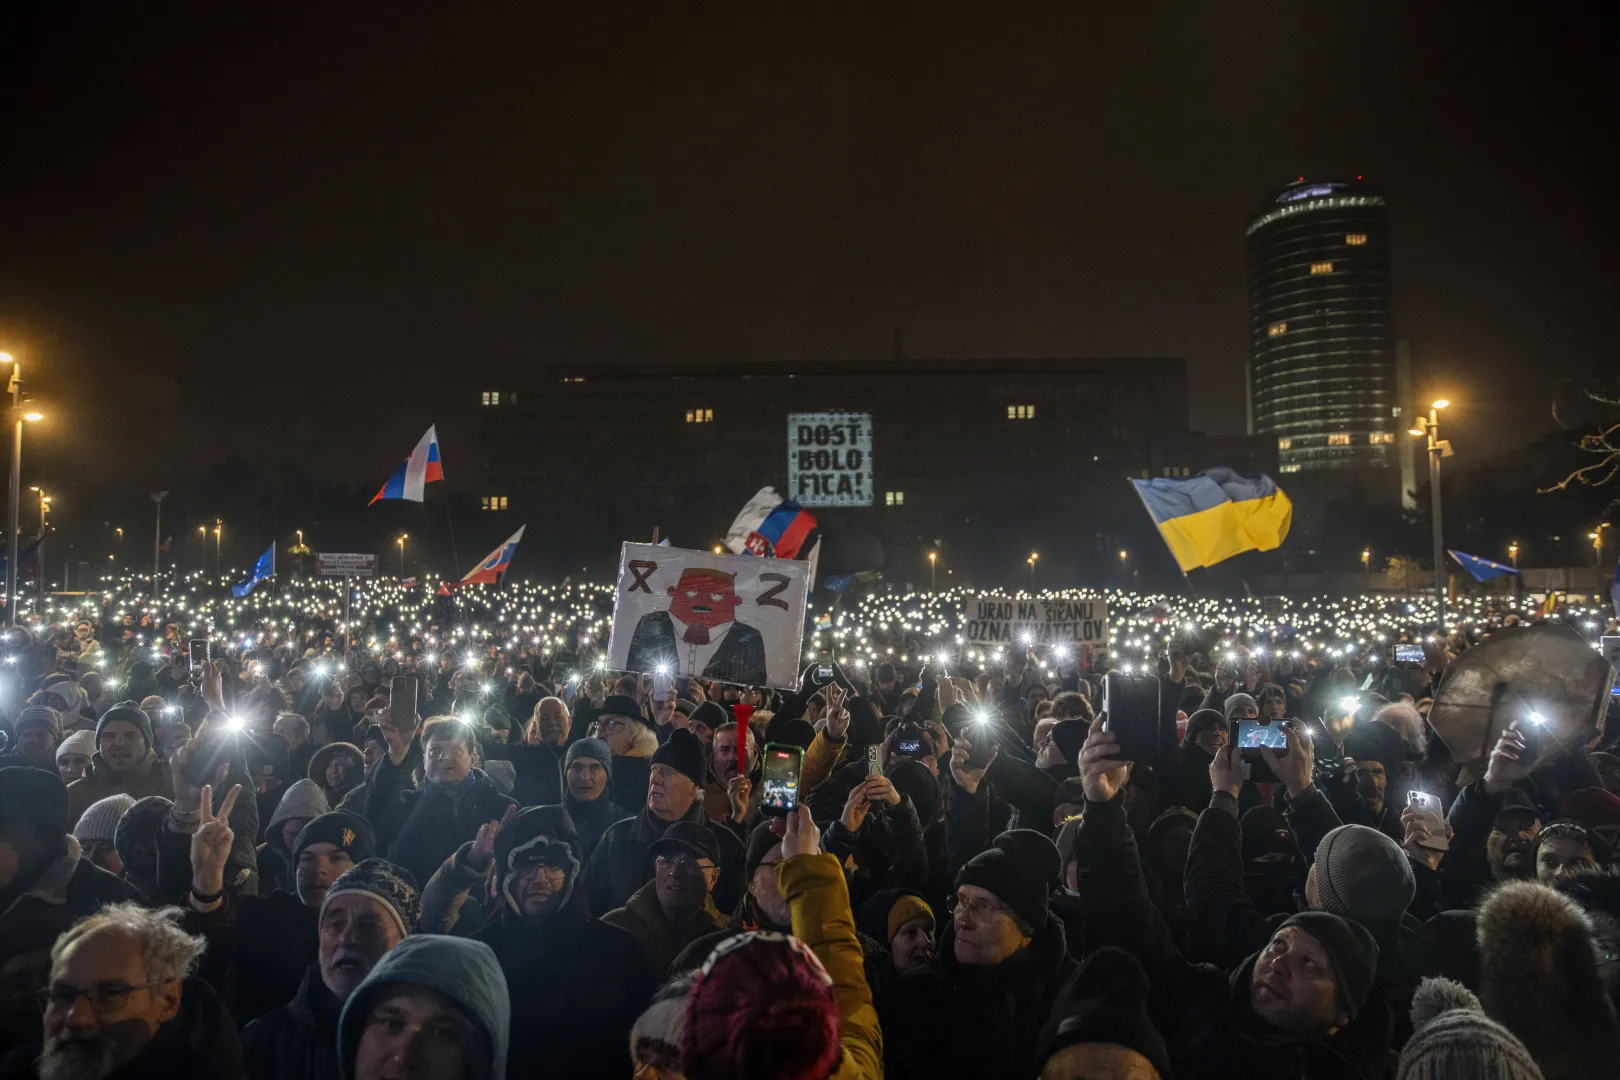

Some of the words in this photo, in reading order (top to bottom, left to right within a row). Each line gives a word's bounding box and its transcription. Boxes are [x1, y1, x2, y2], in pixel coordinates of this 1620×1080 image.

[798, 449, 863, 471] BOLO
[798, 472, 863, 495] FICA!
[1018, 602, 1037, 620] NA
